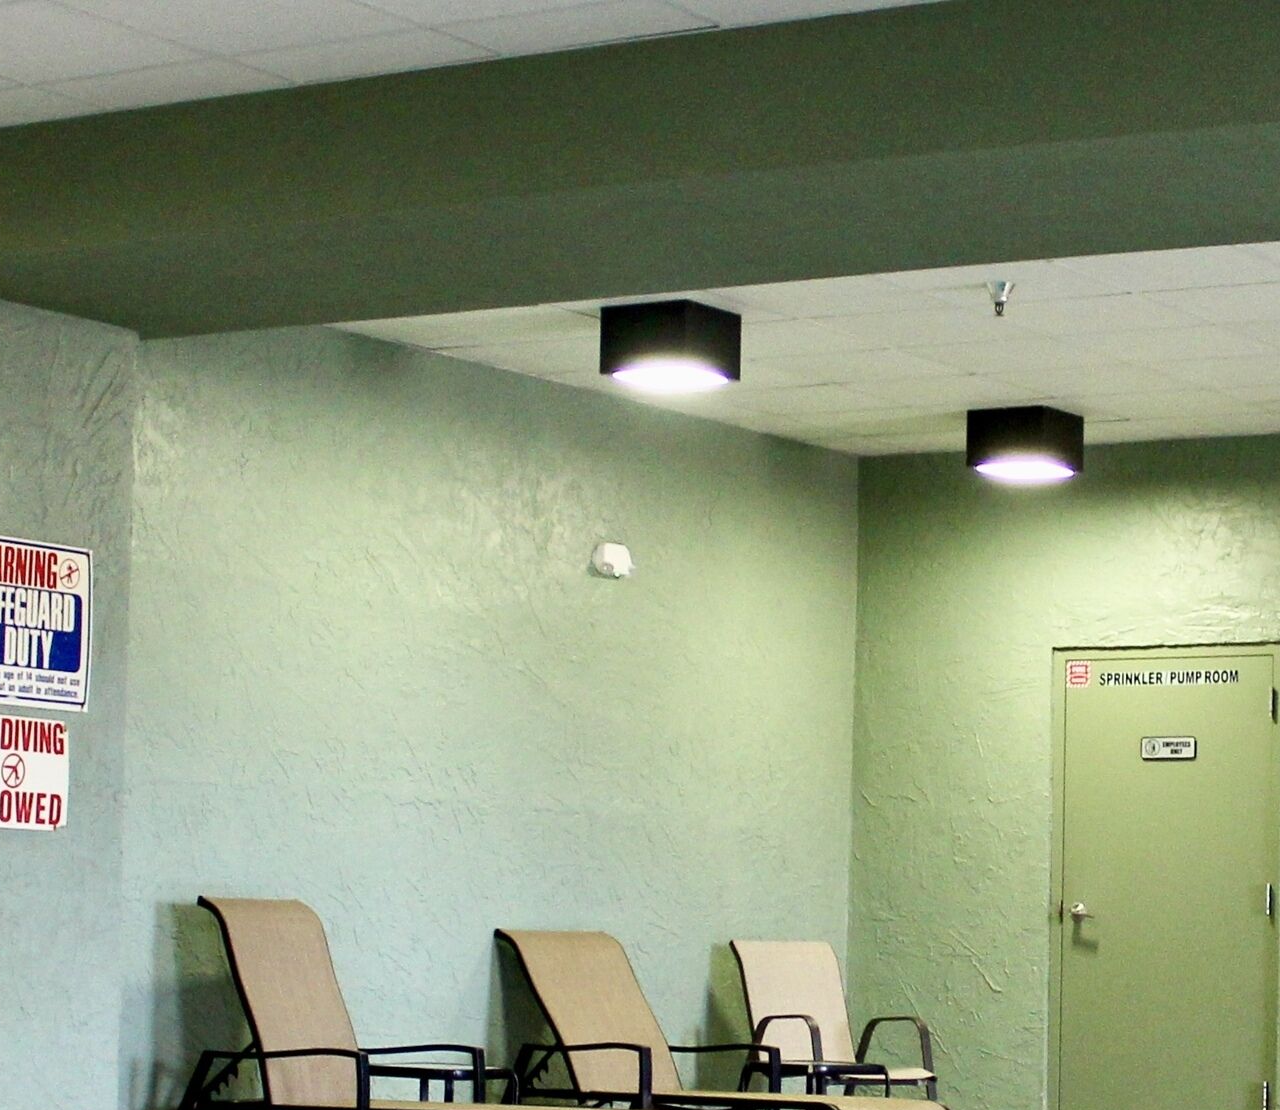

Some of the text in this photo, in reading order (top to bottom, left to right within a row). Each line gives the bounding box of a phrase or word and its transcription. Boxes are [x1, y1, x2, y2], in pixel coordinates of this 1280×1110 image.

[3, 625, 54, 669] DUTY
[4, 671, 14, 681] age
[17, 671, 23, 681] of
[57, 675, 67, 685] not
[1204, 670, 1239, 684] ROOM
[0, 718, 65, 755] DIVING
